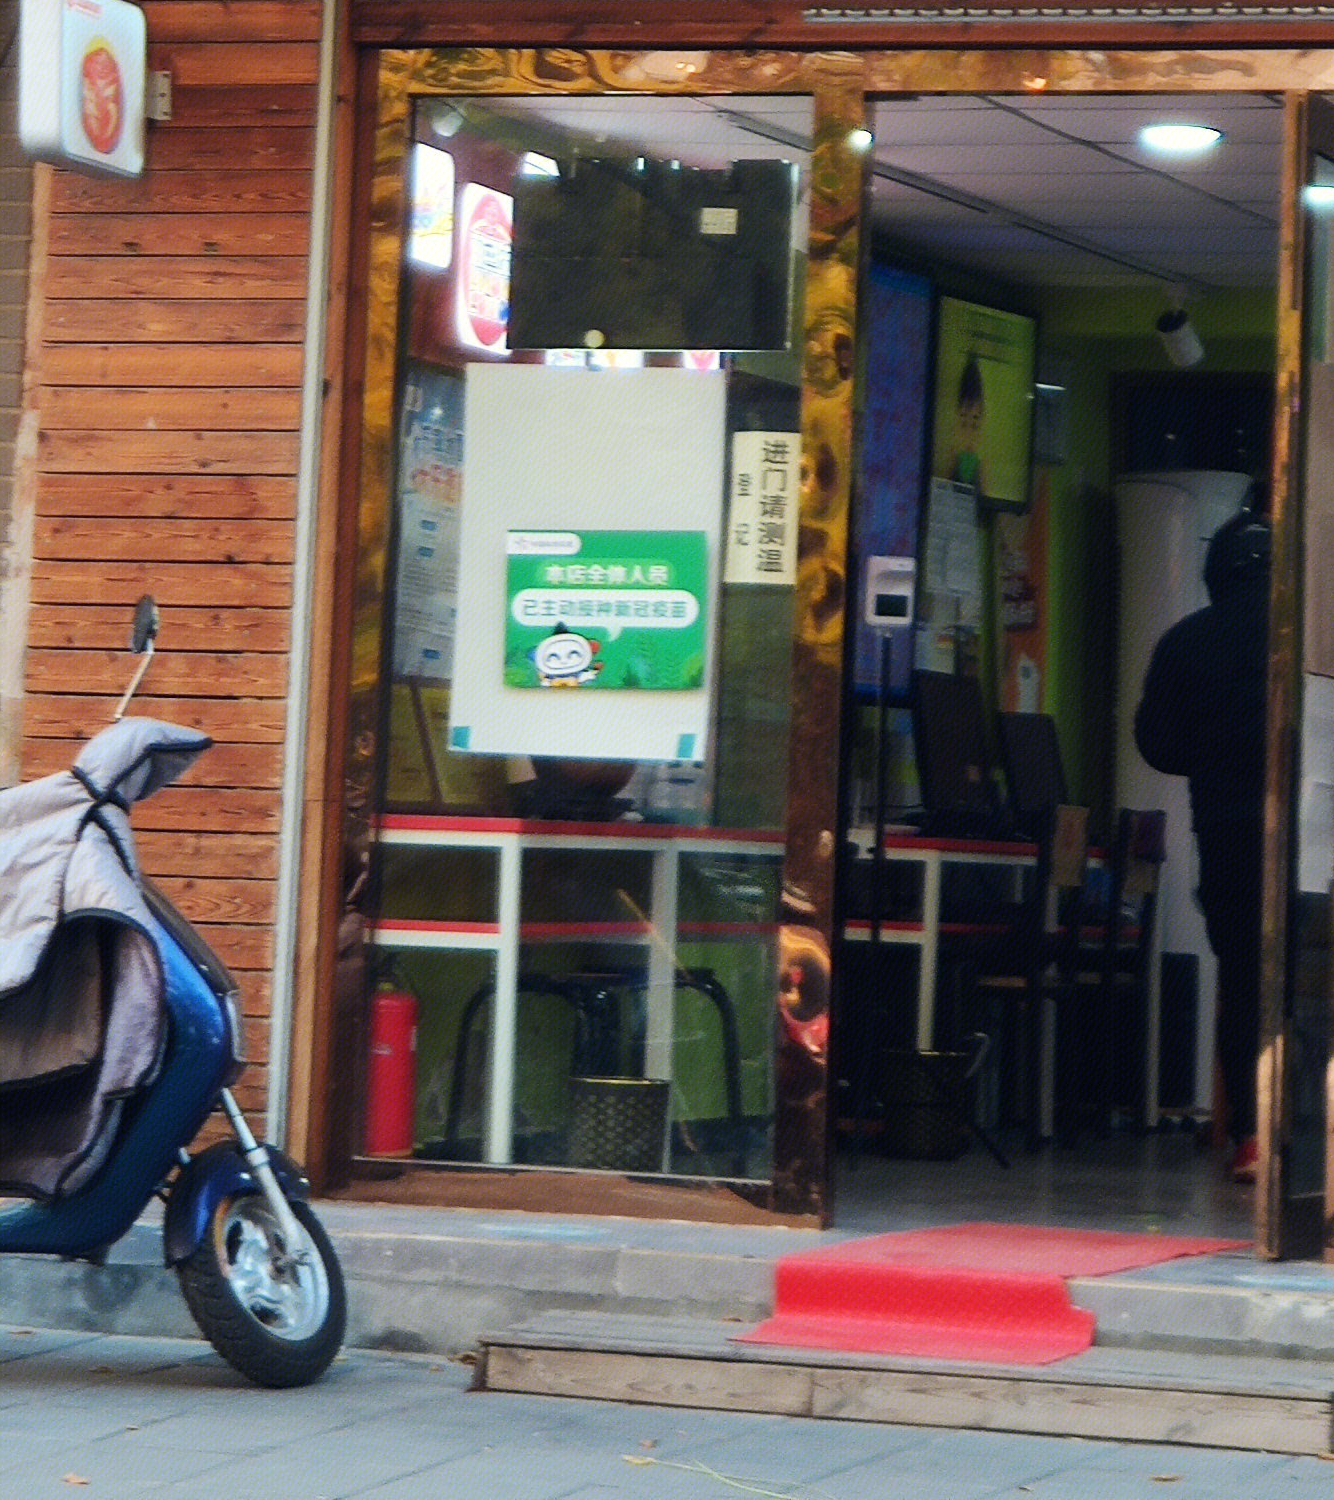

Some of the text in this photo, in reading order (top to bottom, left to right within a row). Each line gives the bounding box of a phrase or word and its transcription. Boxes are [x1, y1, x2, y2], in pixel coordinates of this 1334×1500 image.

[545, 564, 669, 586] 本店全体人员
